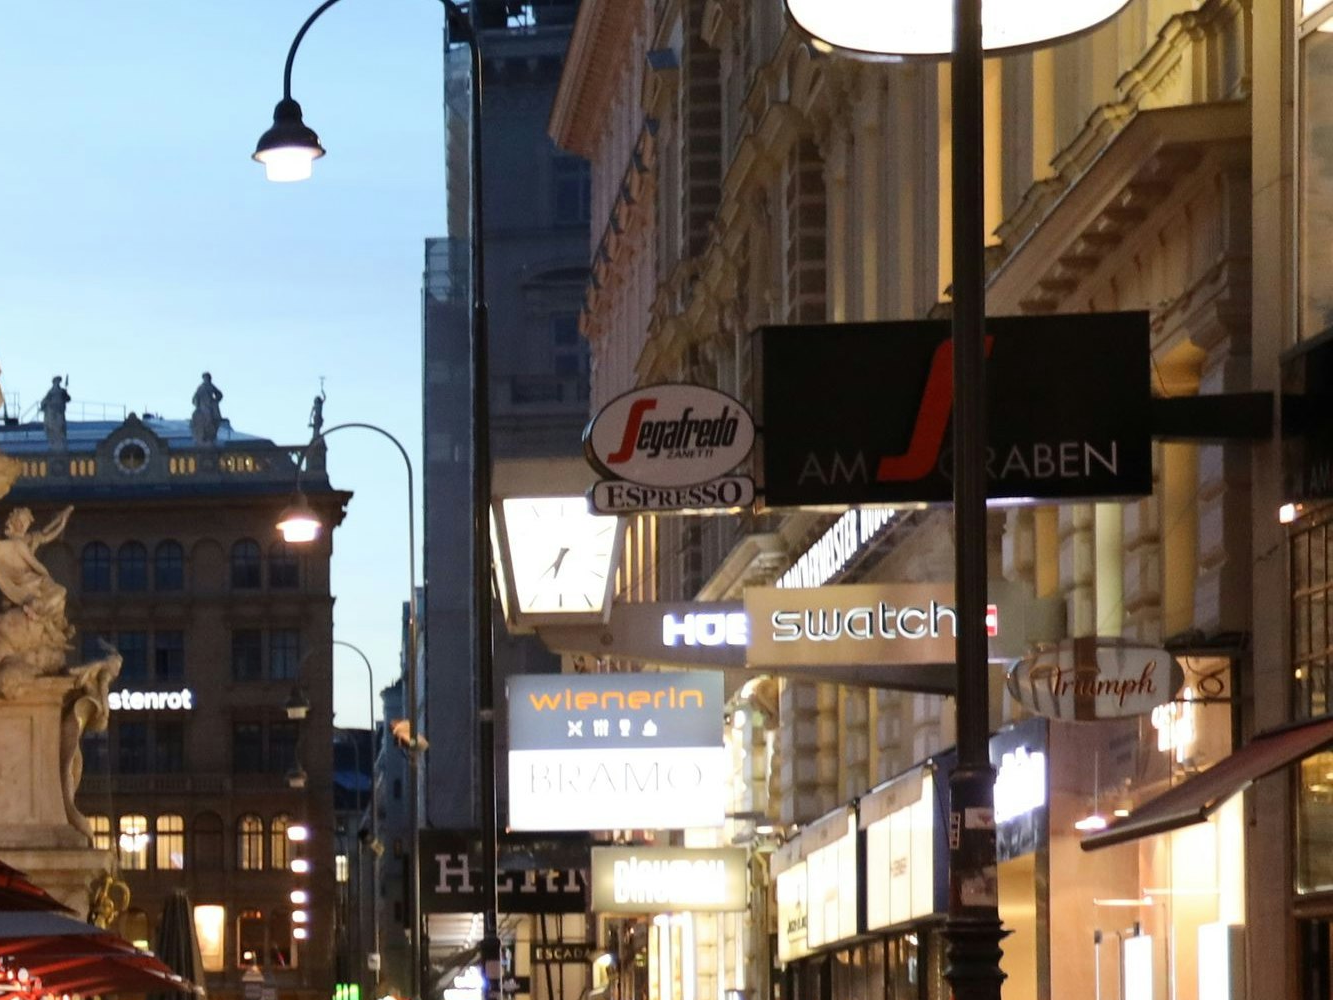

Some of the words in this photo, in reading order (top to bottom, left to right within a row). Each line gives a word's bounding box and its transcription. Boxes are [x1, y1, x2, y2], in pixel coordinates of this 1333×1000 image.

[606, 398, 738, 464] Segafredo
[667, 449, 713, 460] ZANETTI
[798, 451, 868, 485] AM
[606, 481, 742, 509] ESPRESSO
[772, 600, 957, 641] swatch
[108, 688, 192, 710] stenrot
[530, 686, 705, 711] wienerin
[1030, 661, 1157, 707] Triumph
[531, 762, 702, 793] BRAMO
